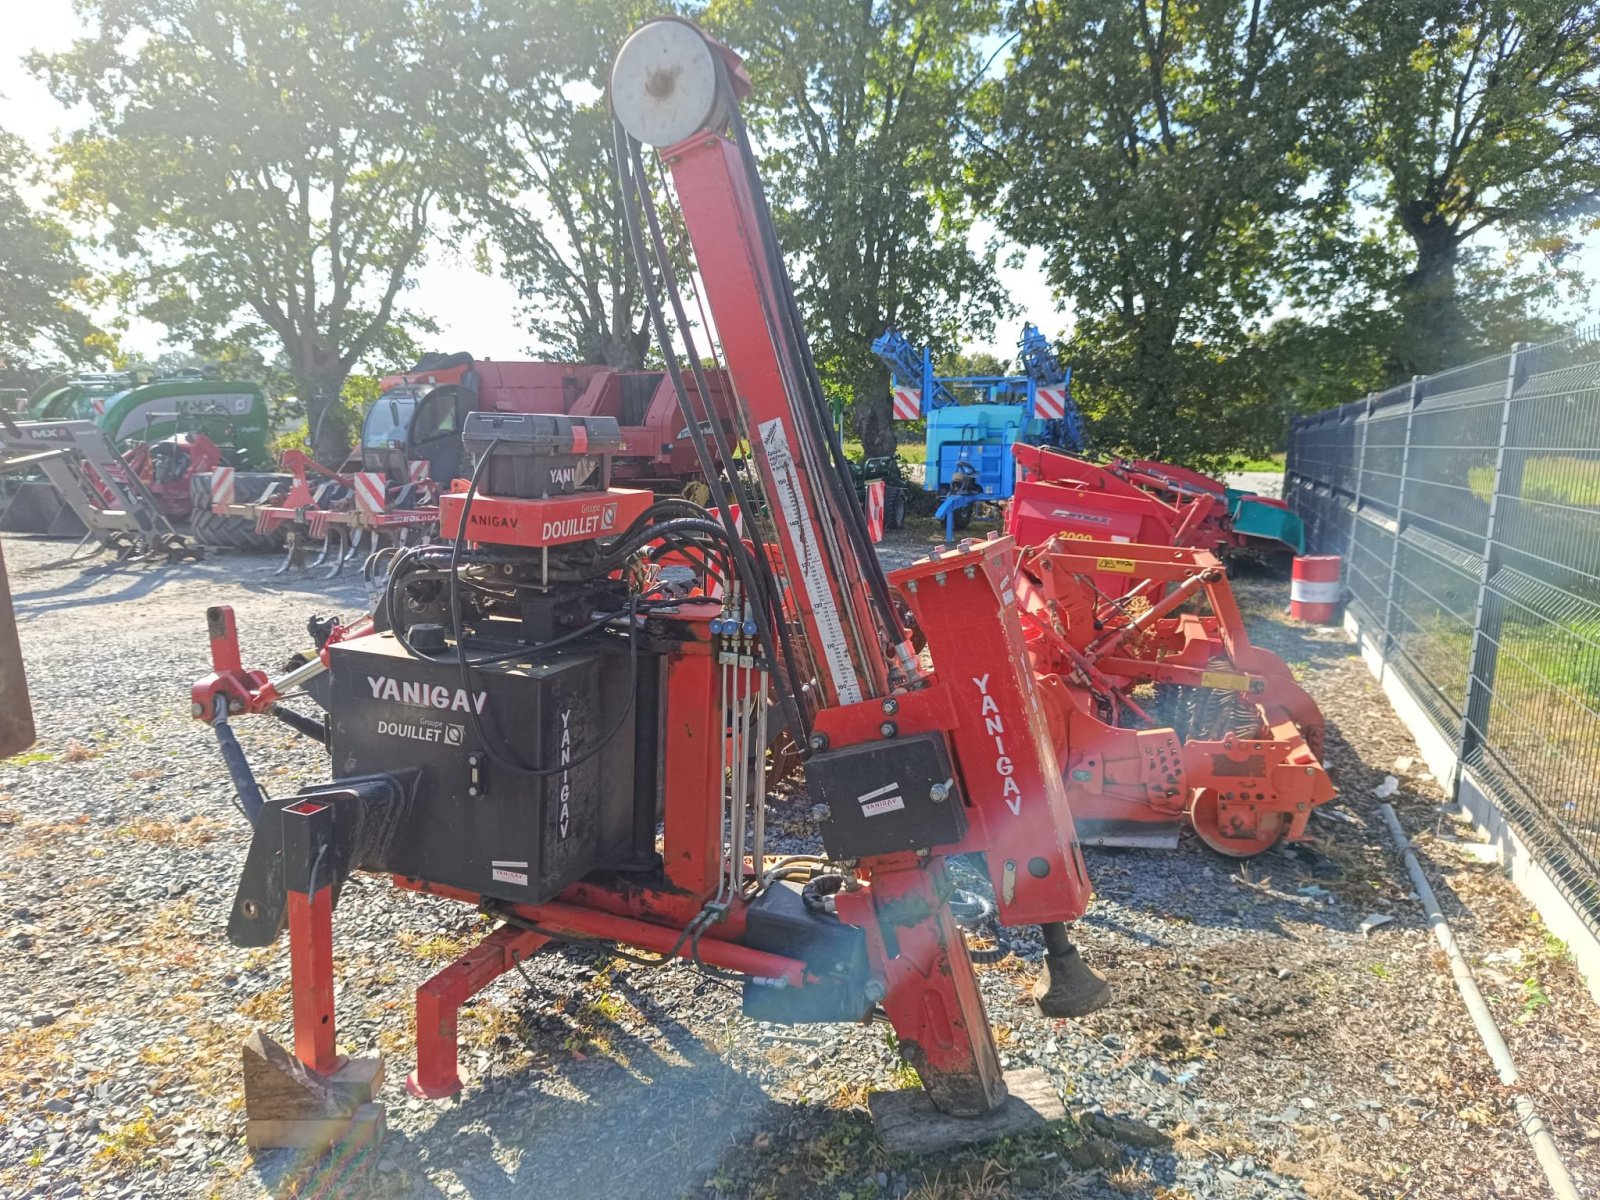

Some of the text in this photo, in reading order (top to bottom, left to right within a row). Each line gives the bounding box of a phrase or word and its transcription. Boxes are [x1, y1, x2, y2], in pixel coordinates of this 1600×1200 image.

[471, 514, 518, 529] ANIGAV
[542, 515, 600, 541] DOUILLET
[367, 676, 487, 715] YANIGAV
[378, 721, 442, 743] DOUILLET
[420, 717, 443, 728] Groupe
[972, 673, 1021, 816] YANIGAV
[560, 708, 571, 839] YANIGAV
